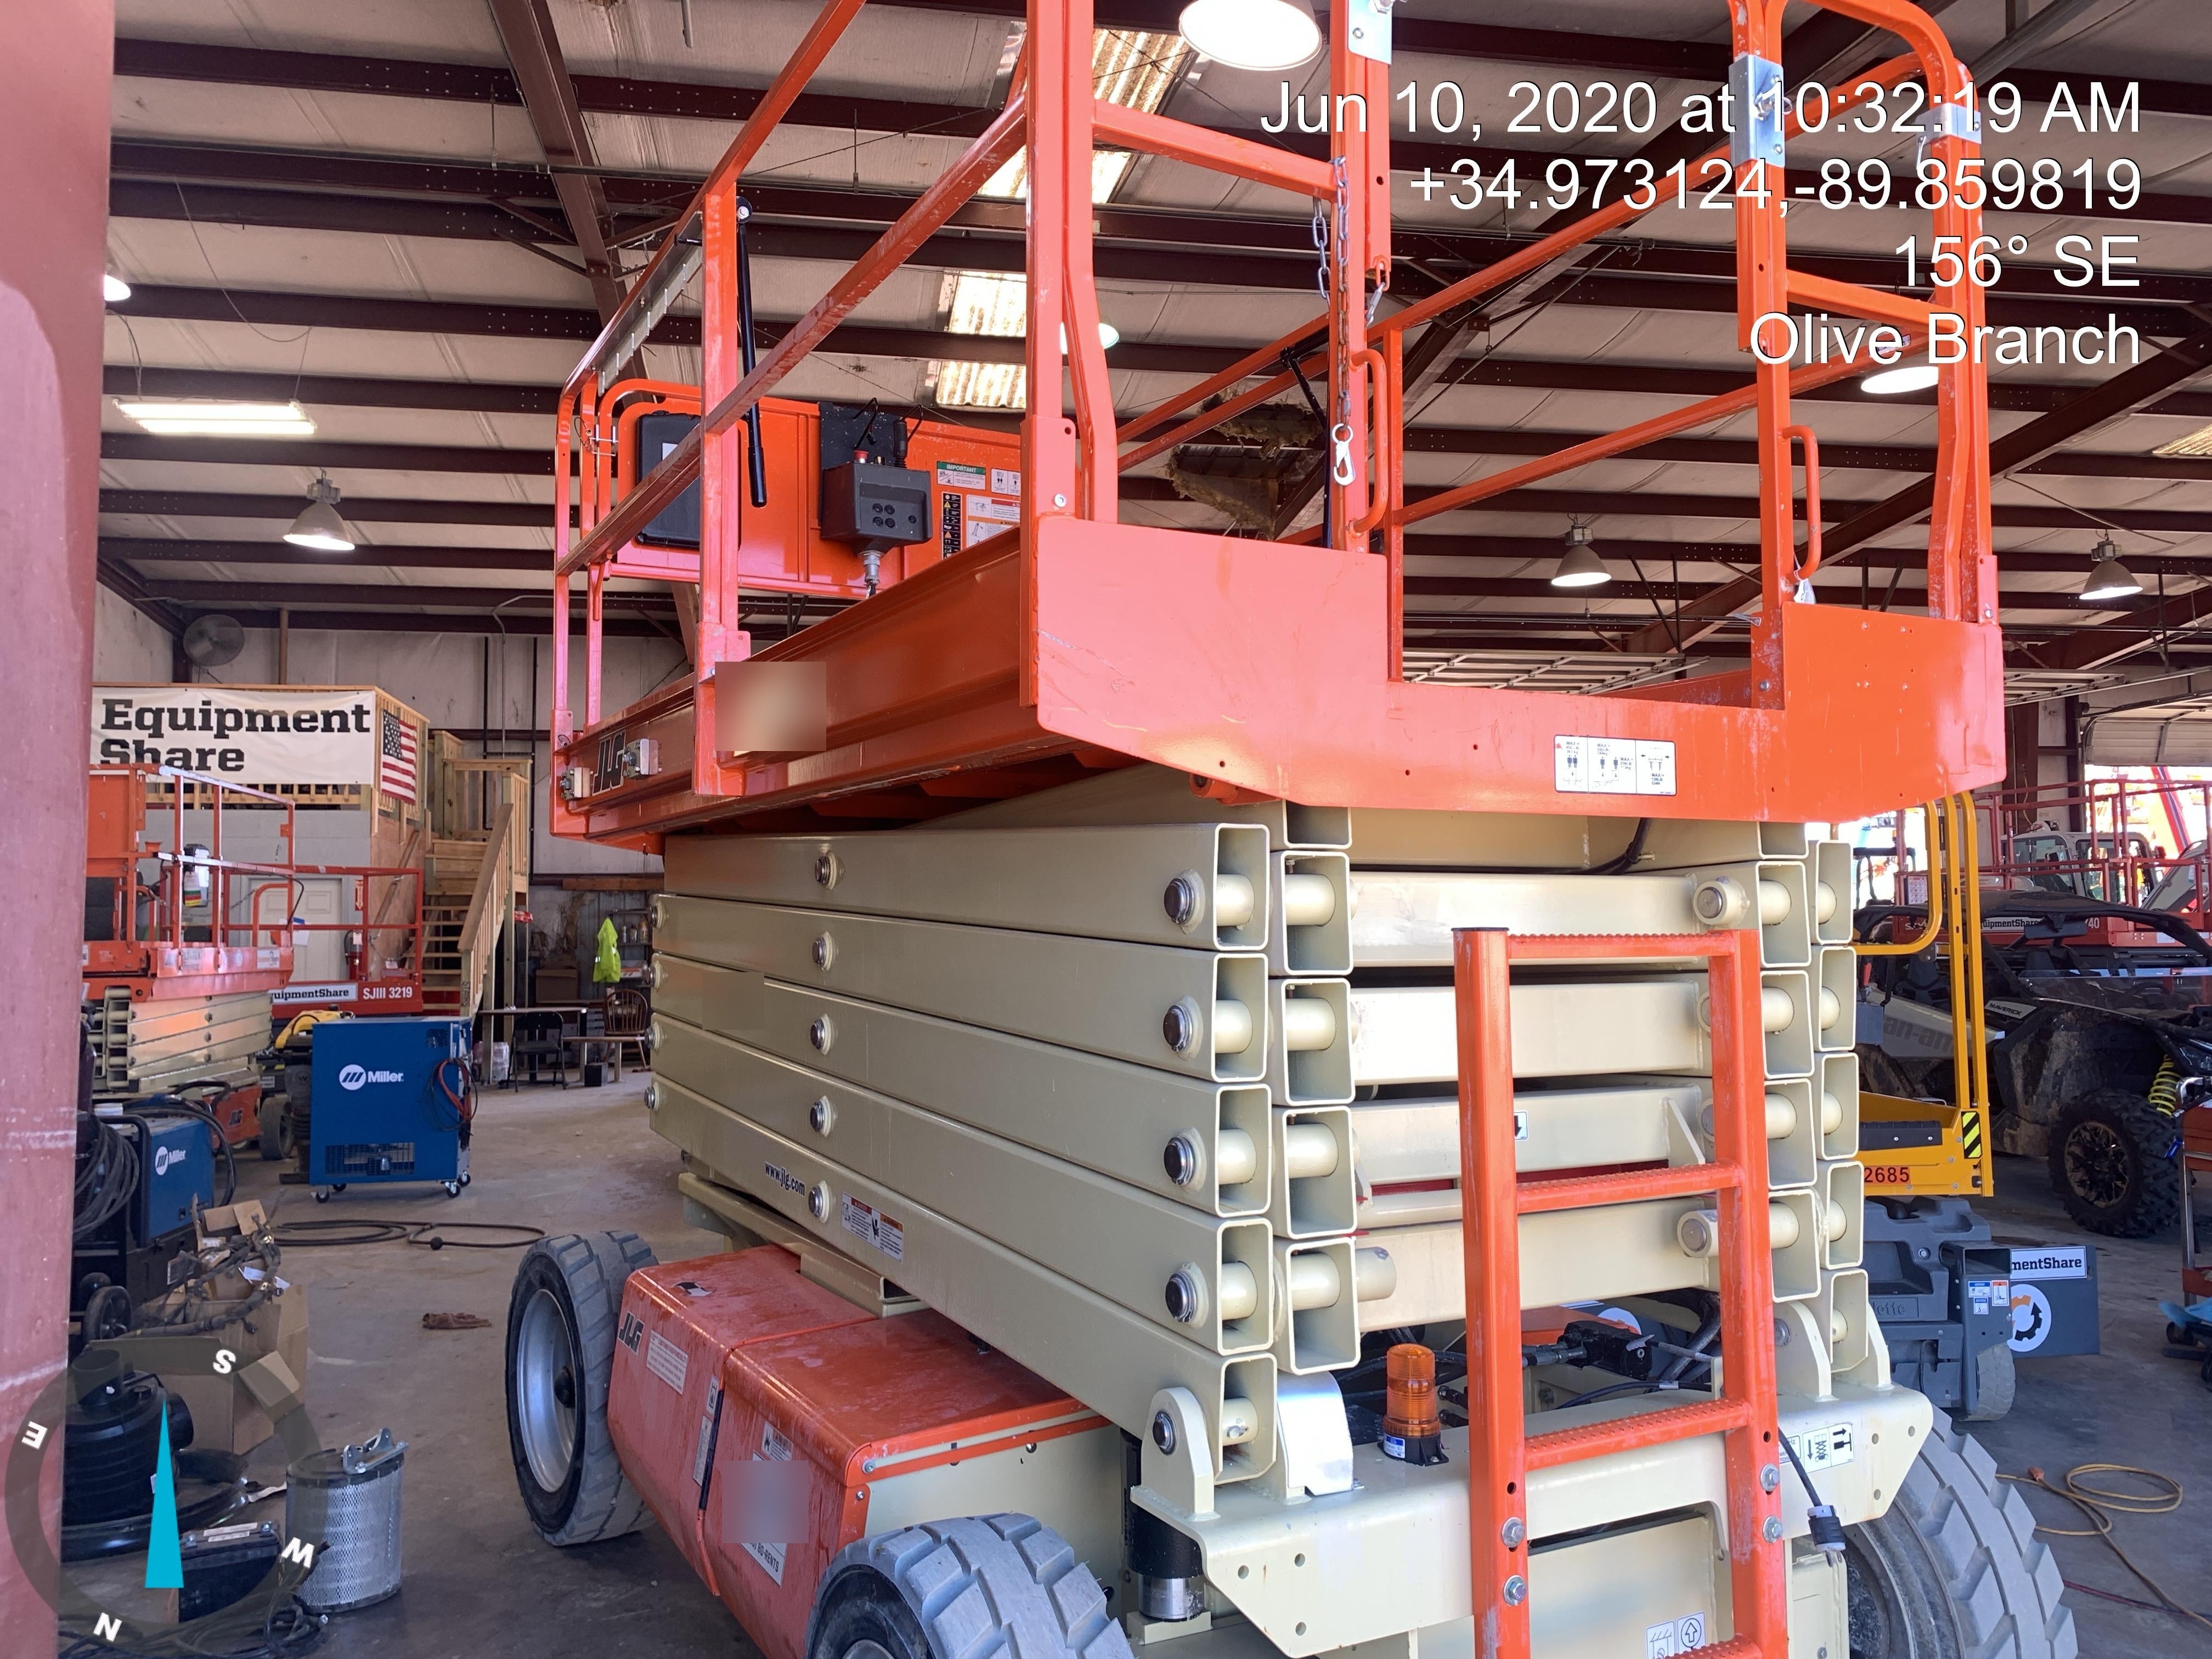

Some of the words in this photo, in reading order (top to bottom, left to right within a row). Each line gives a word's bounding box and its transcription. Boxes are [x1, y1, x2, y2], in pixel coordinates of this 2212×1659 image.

[946, 464, 977, 473] IMPORTANT
[100, 699, 371, 739] Equipment
[100, 738, 245, 772] Share
[592, 731, 625, 795] JLG
[2085, 917, 2100, 929] 40
[272, 988, 349, 1001] uipmentShare
[388, 986, 413, 999] 3219
[1989, 1003, 2023, 1016] MAVERICK
[1883, 1015, 1954, 1053] an-am
[368, 1070, 404, 1083] Miller
[765, 1163, 805, 1197] www.jlg.com
[1864, 1167, 1909, 1183] 2685
[2012, 1257, 2082, 1271] mentShare
[619, 1312, 644, 1353] JLG
